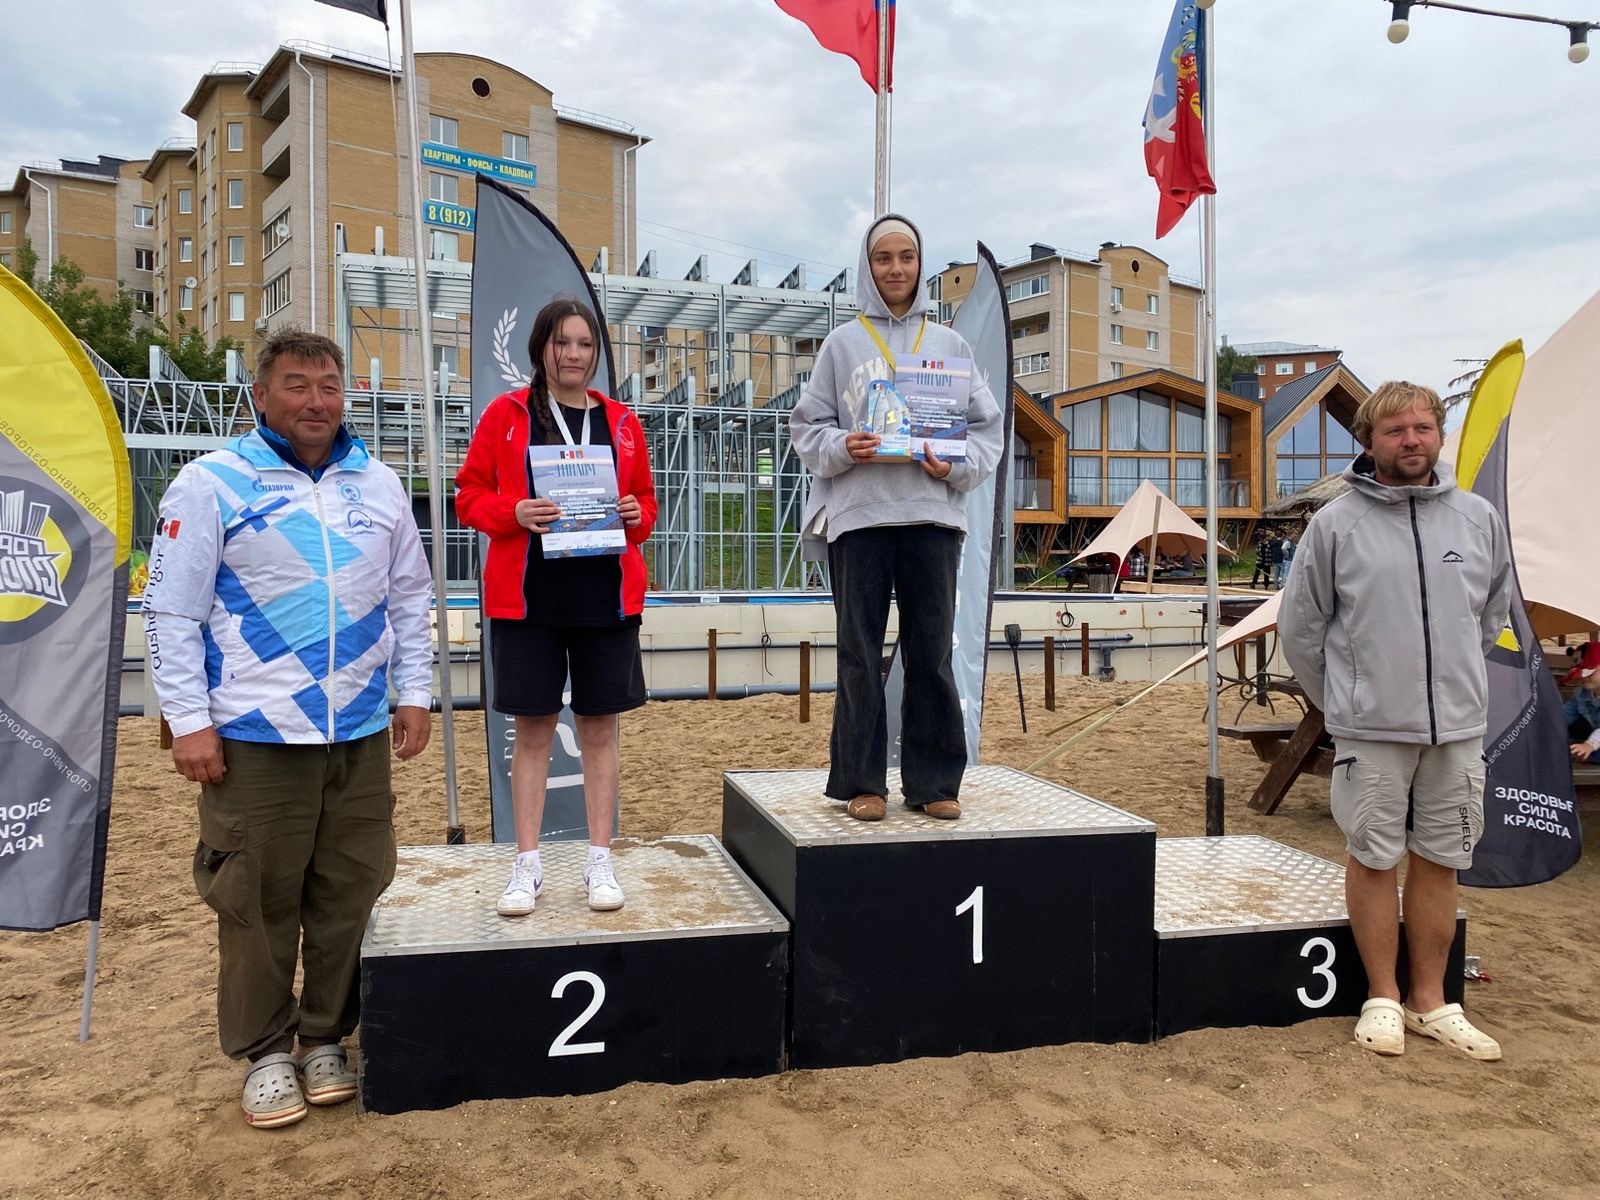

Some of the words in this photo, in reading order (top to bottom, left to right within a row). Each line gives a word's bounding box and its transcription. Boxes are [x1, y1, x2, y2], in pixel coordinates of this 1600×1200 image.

[423, 147, 461, 165] КВАРТИРЫ
[467, 157, 493, 171] ОФИСЫ
[499, 164, 534, 180] КЛАДОВЫЕ
[428, 204, 437, 221] 8
[440, 206, 471, 228] (912)
[886, 410, 897, 425] 1
[264, 483, 295, 492] ГАЗПРОМ
[1495, 786, 1574, 814] ЗДОРОВЬЕ
[1518, 802, 1559, 822] СИЛА
[1458, 806, 1472, 853] SMELO
[1503, 813, 1572, 839] КРАСОТА
[955, 885, 984, 964] 1
[1296, 937, 1337, 1009] 3
[548, 970, 606, 1057] 2
